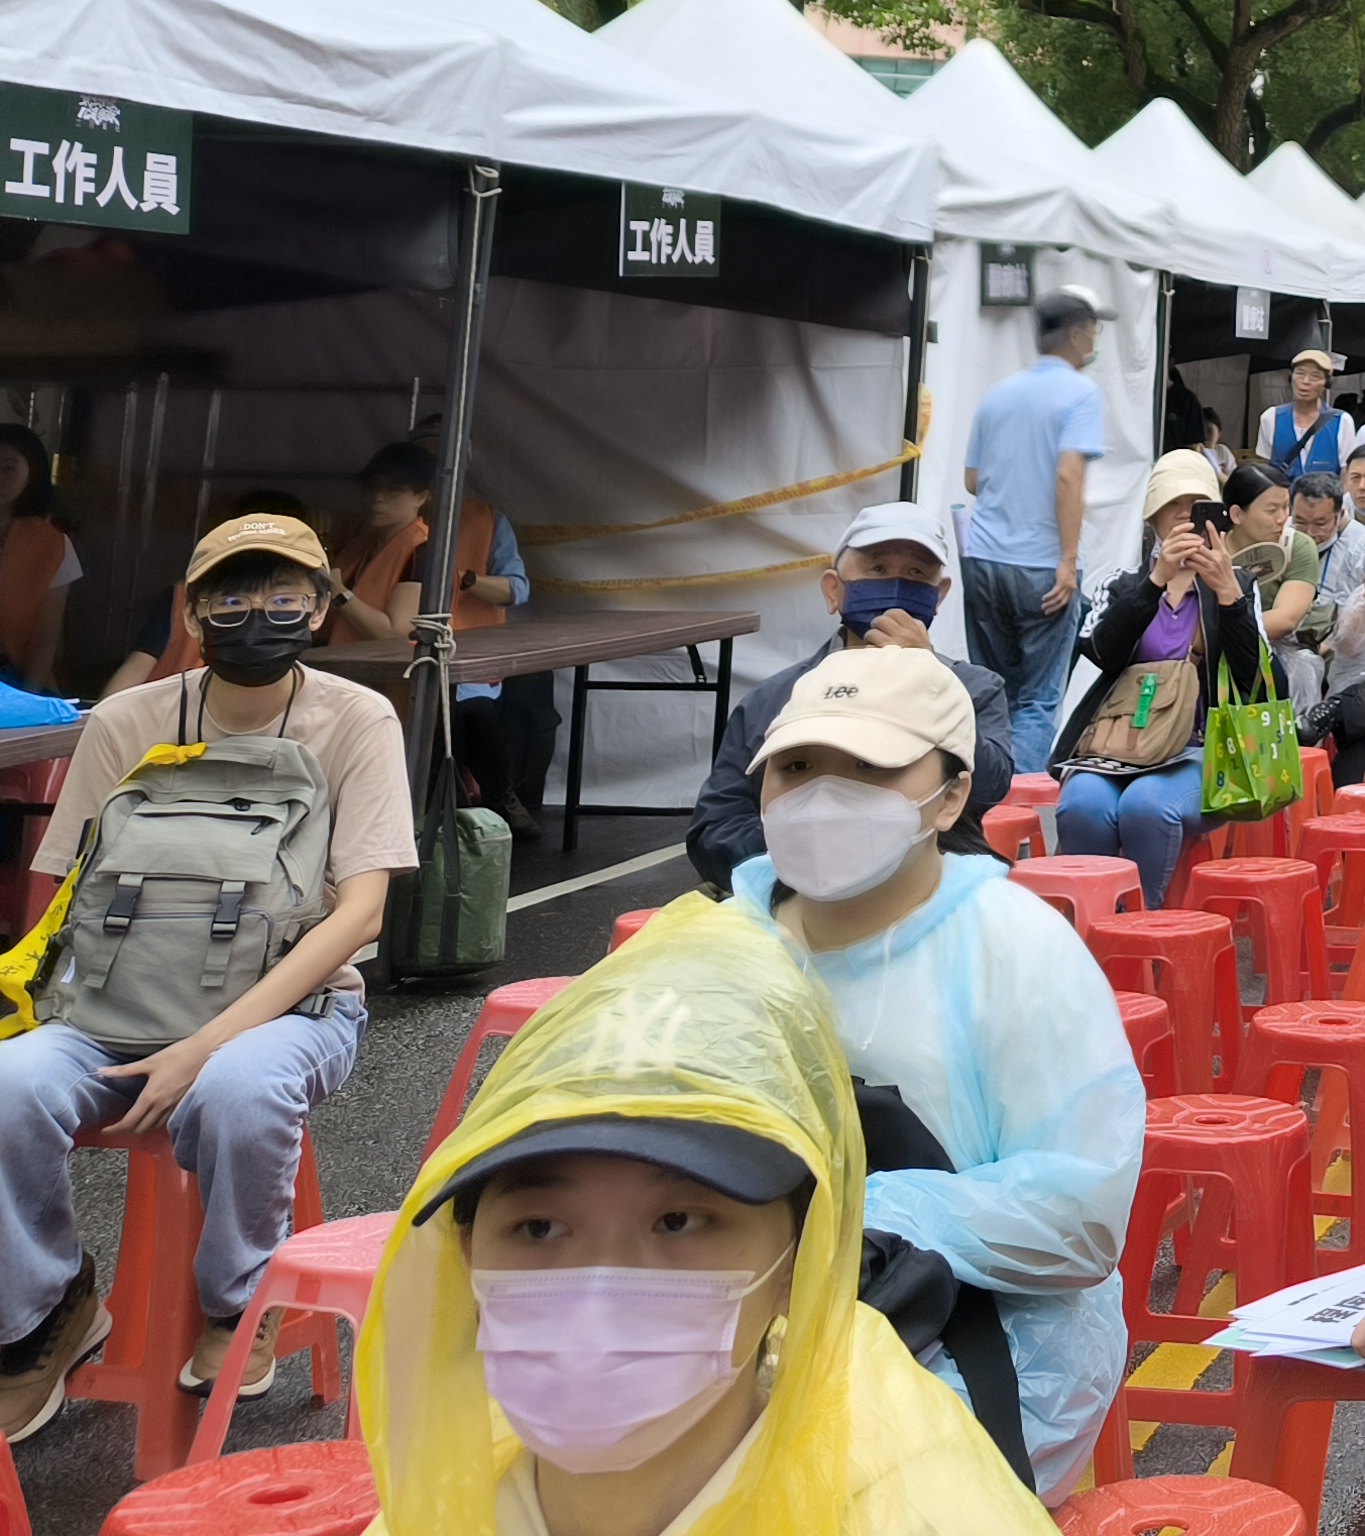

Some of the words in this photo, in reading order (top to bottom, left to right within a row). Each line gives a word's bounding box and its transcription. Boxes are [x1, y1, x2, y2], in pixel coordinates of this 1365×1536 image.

[5, 138, 181, 215] 工作人員
[627, 217, 716, 264] 工作人員
[824, 685, 859, 699] Lee
